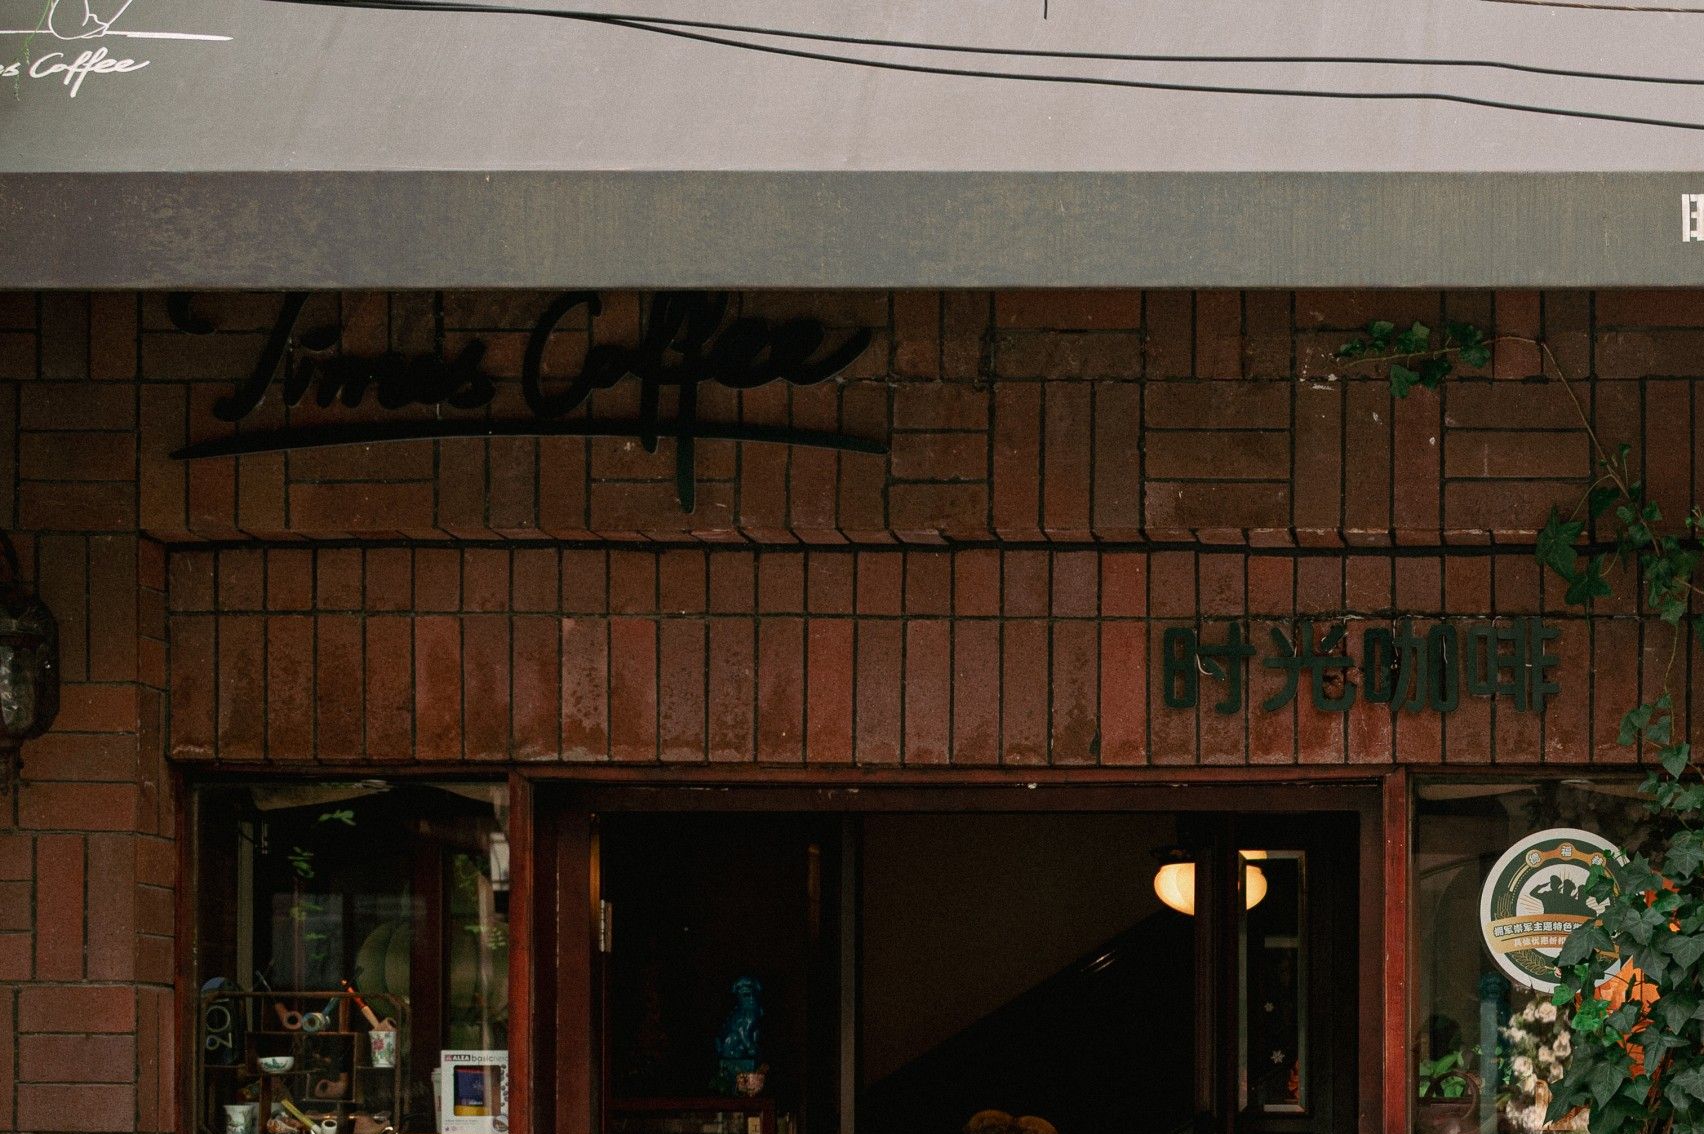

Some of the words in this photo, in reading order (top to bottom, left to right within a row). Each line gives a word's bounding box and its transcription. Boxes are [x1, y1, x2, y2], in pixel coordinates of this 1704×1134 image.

[29, 46, 150, 98] Coffee
[1163, 618, 1562, 716] 时光咖啡
